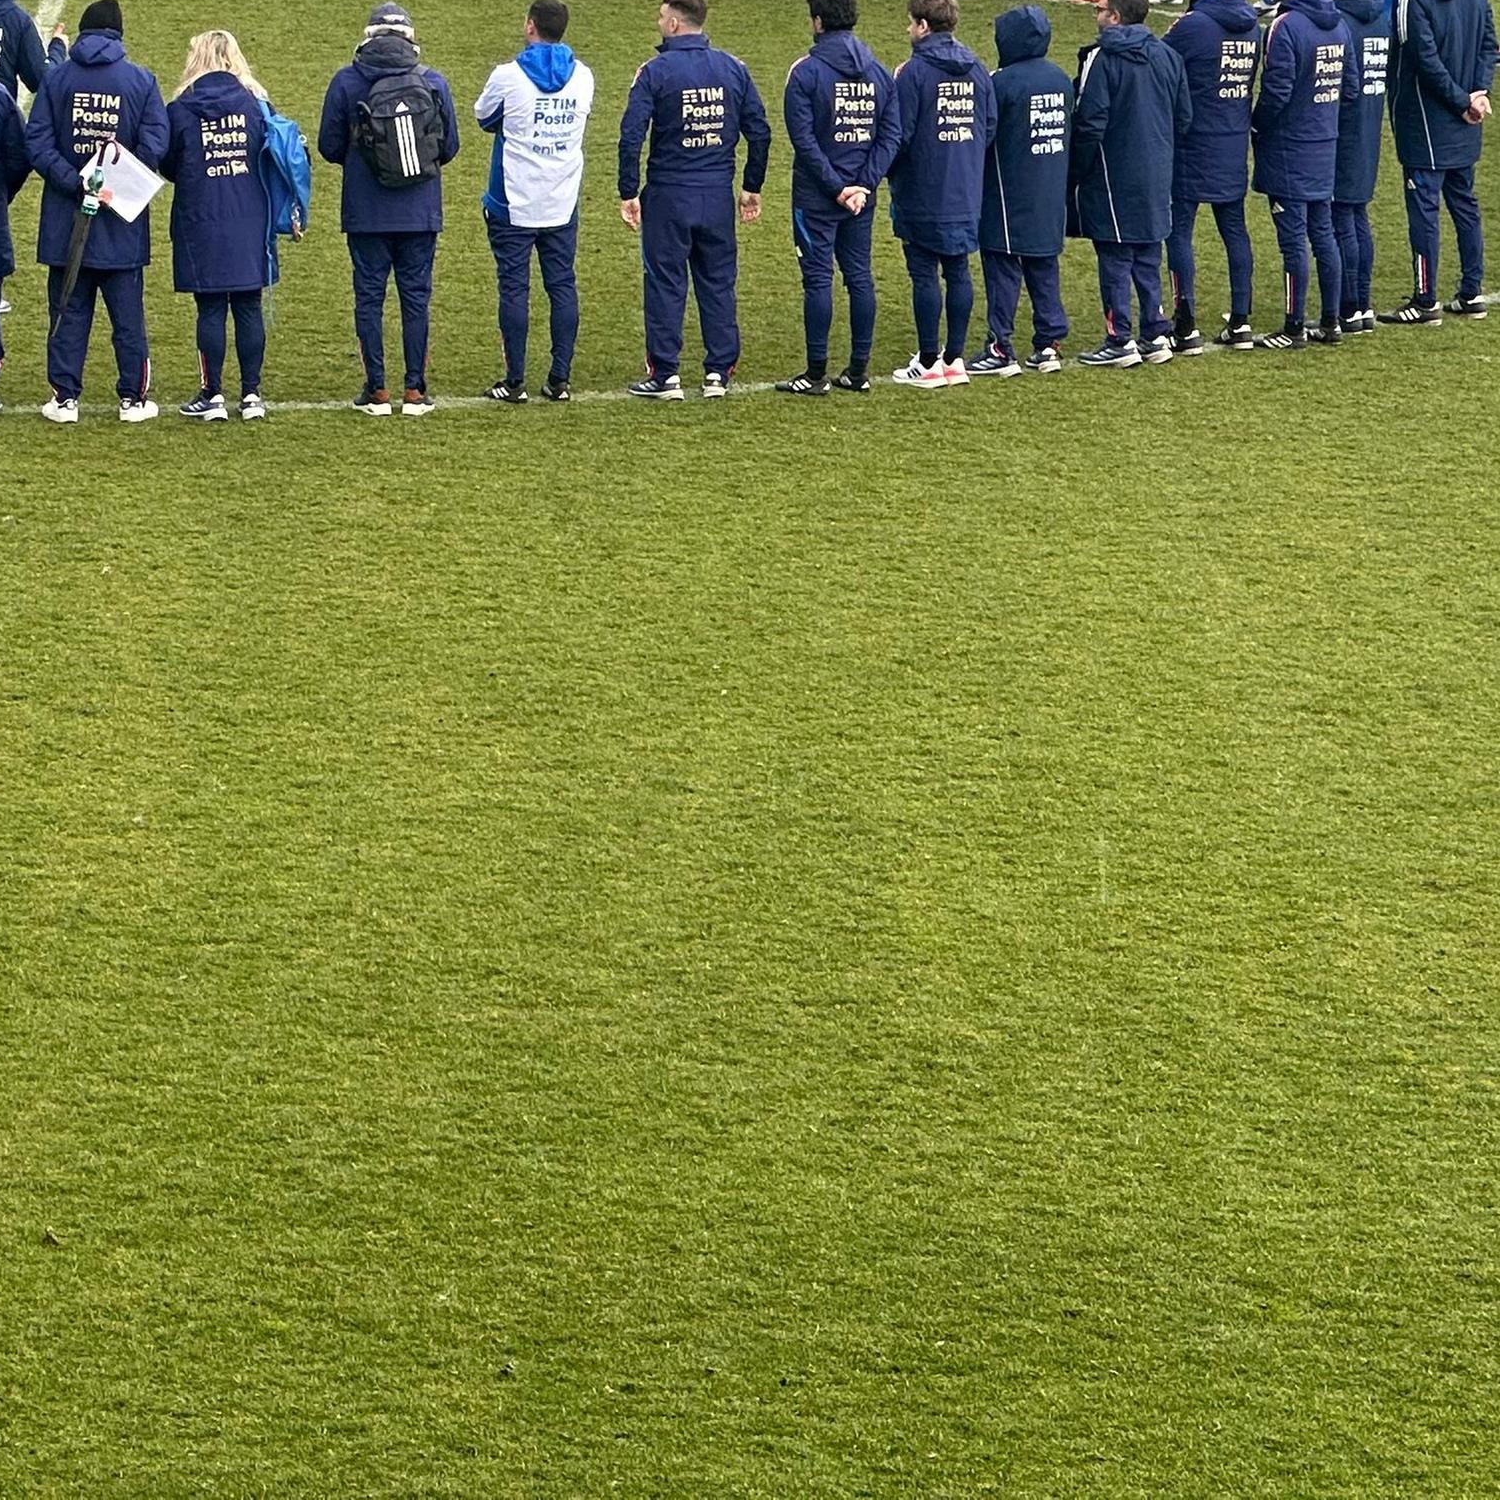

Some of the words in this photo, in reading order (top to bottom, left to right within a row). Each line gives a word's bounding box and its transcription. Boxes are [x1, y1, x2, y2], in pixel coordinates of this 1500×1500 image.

[1220, 55, 1254, 69] Poste
[698, 86, 724, 102] TIM
[849, 82, 875, 96] TIM
[951, 82, 974, 96] TIM
[1219, 84, 1240, 98] eni
[91, 93, 121, 109] TIM
[552, 98, 577, 110] TIM
[835, 97, 876, 111] Poste
[937, 97, 975, 111] Poste
[1042, 92, 1065, 108] TIM
[72, 108, 119, 125] Poste
[682, 104, 725, 118] Poste
[533, 112, 575, 125] Poste
[201, 130, 247, 147] Poste
[682, 133, 706, 148] eni
[834, 128, 857, 142] eni
[938, 127, 959, 141] eni
[73, 140, 94, 154] eni
[1031, 139, 1051, 155] eni
[206, 161, 231, 177] eni
